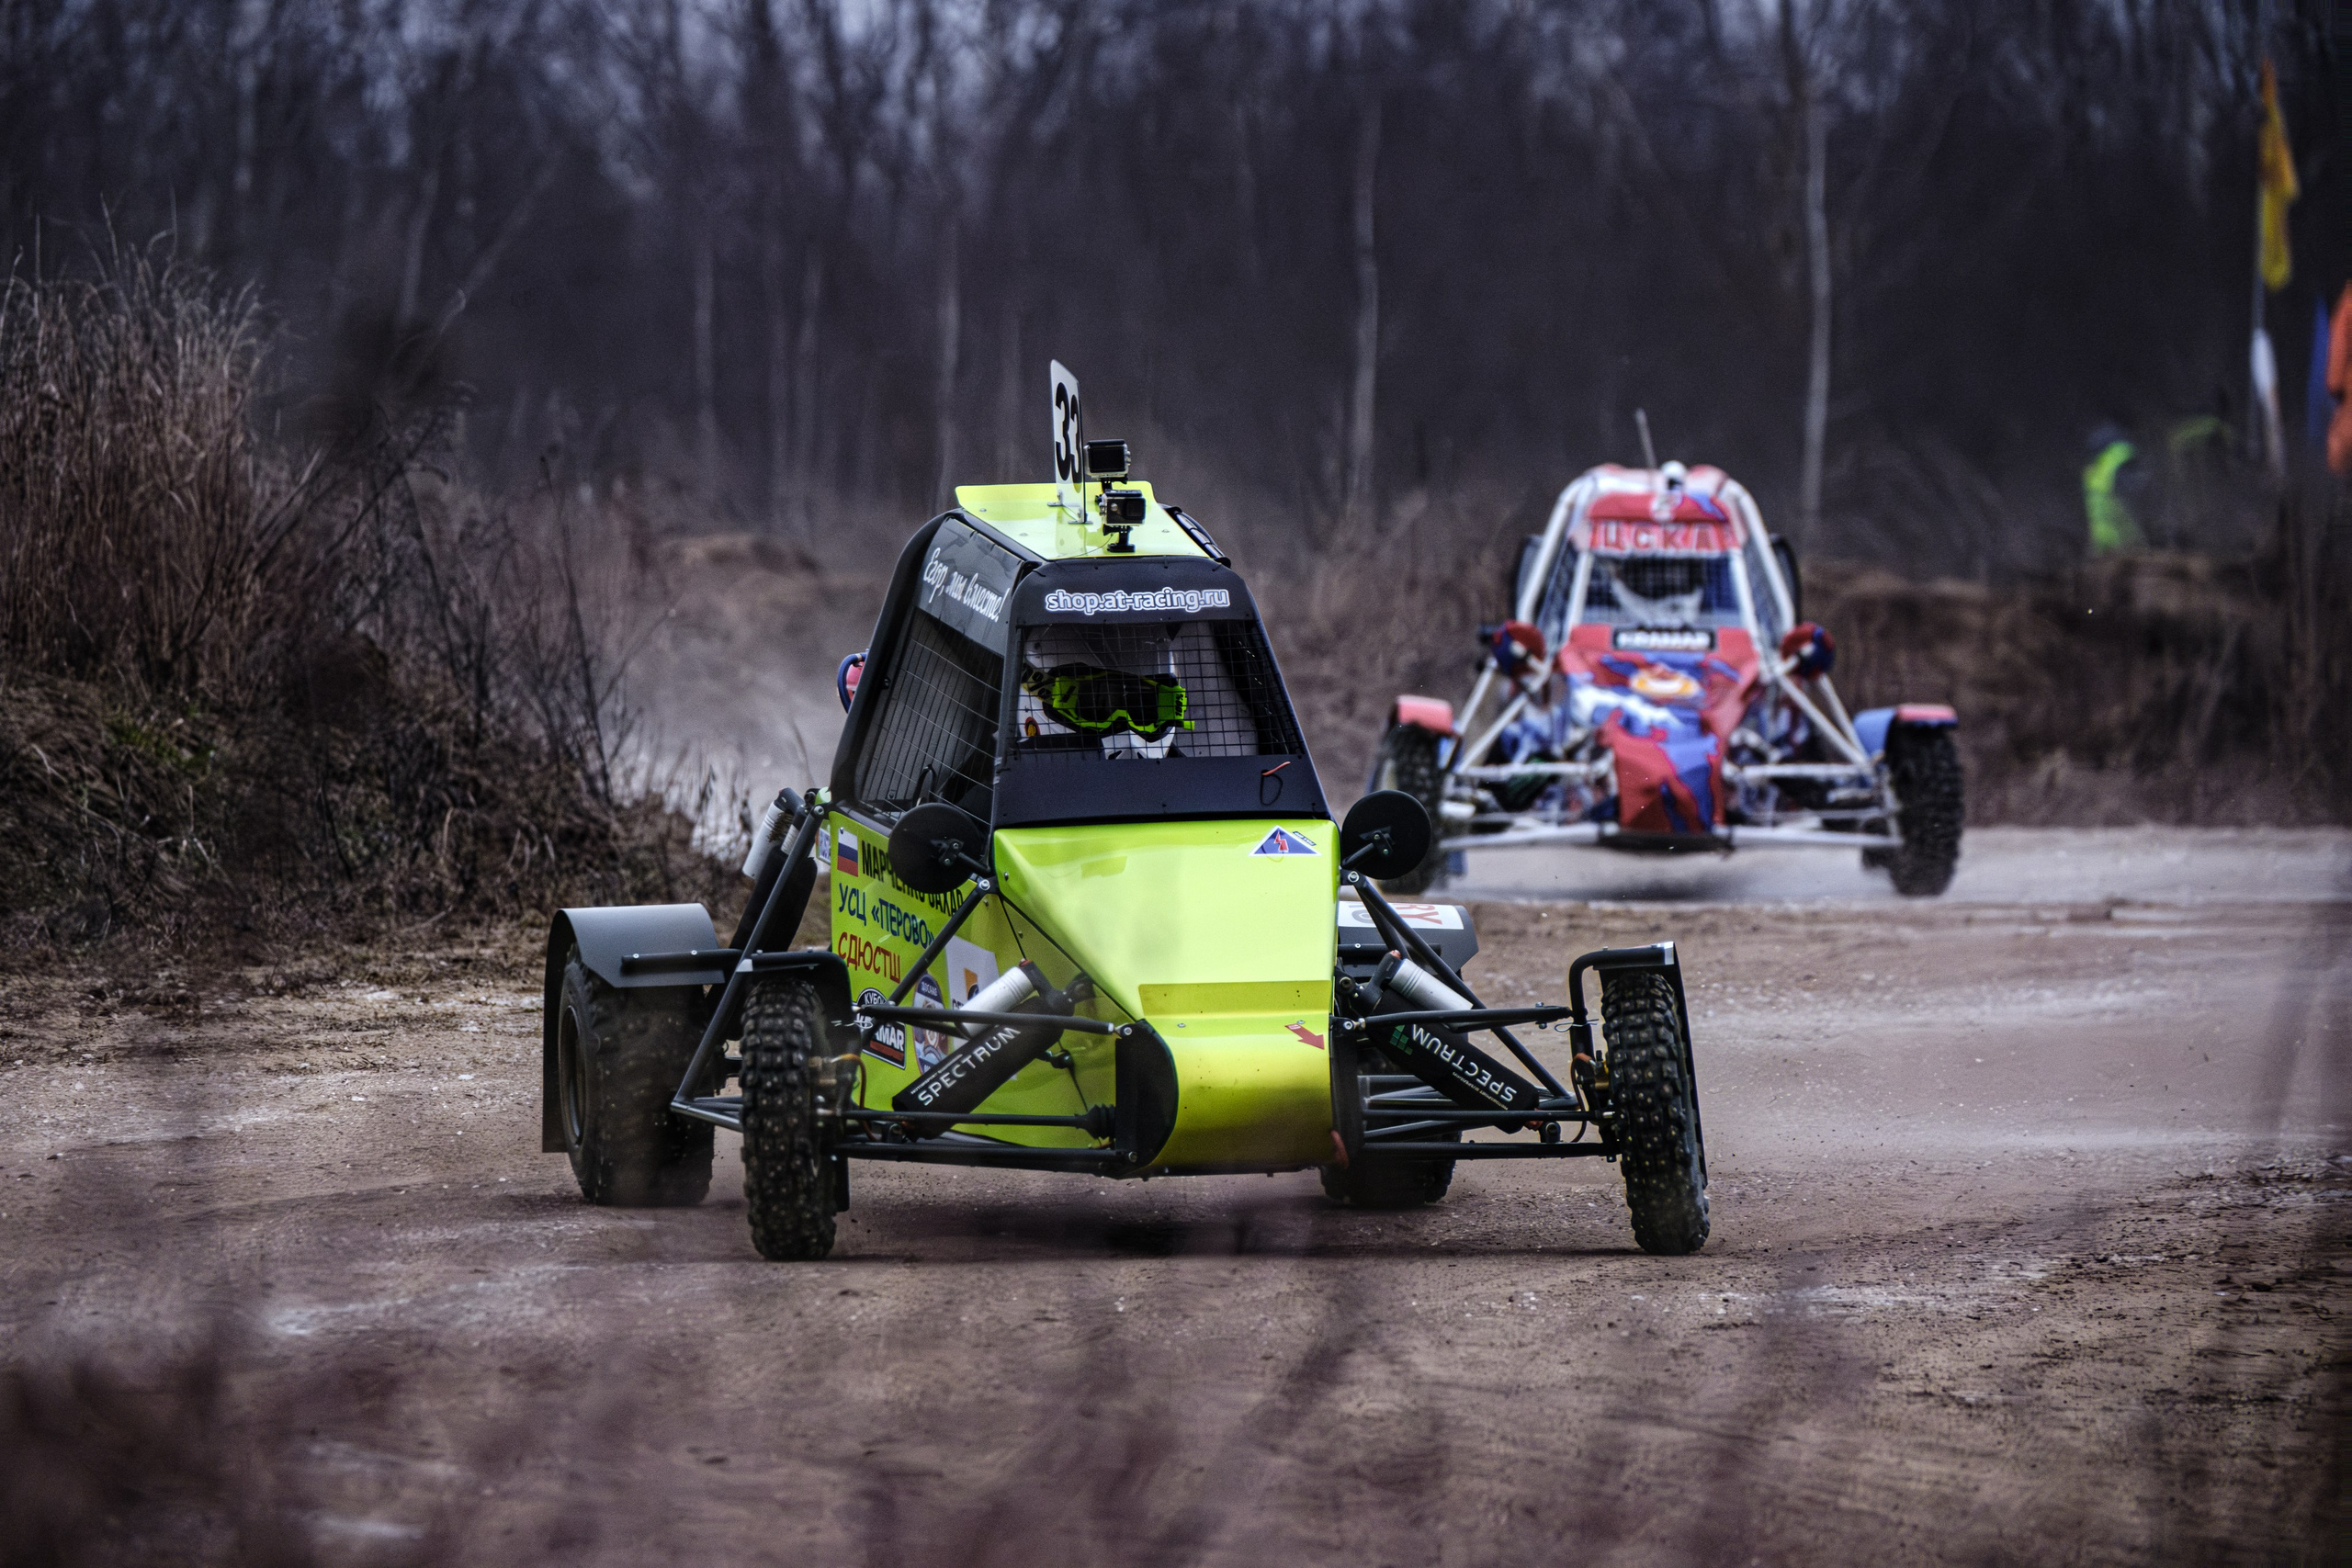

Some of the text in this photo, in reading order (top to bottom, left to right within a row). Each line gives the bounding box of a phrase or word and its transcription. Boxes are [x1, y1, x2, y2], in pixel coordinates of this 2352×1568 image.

[1055, 382, 1082, 493] 33
[1604, 523, 1716, 551] ЦСКА
[1046, 587, 1231, 615] shop.at-racing.ru
[839, 883, 867, 927] УСЦ
[838, 931, 901, 984] СДЮСТШ
[918, 1027, 1022, 1106] SPECTRUM
[1412, 1023, 1518, 1102] SPECTRUM
